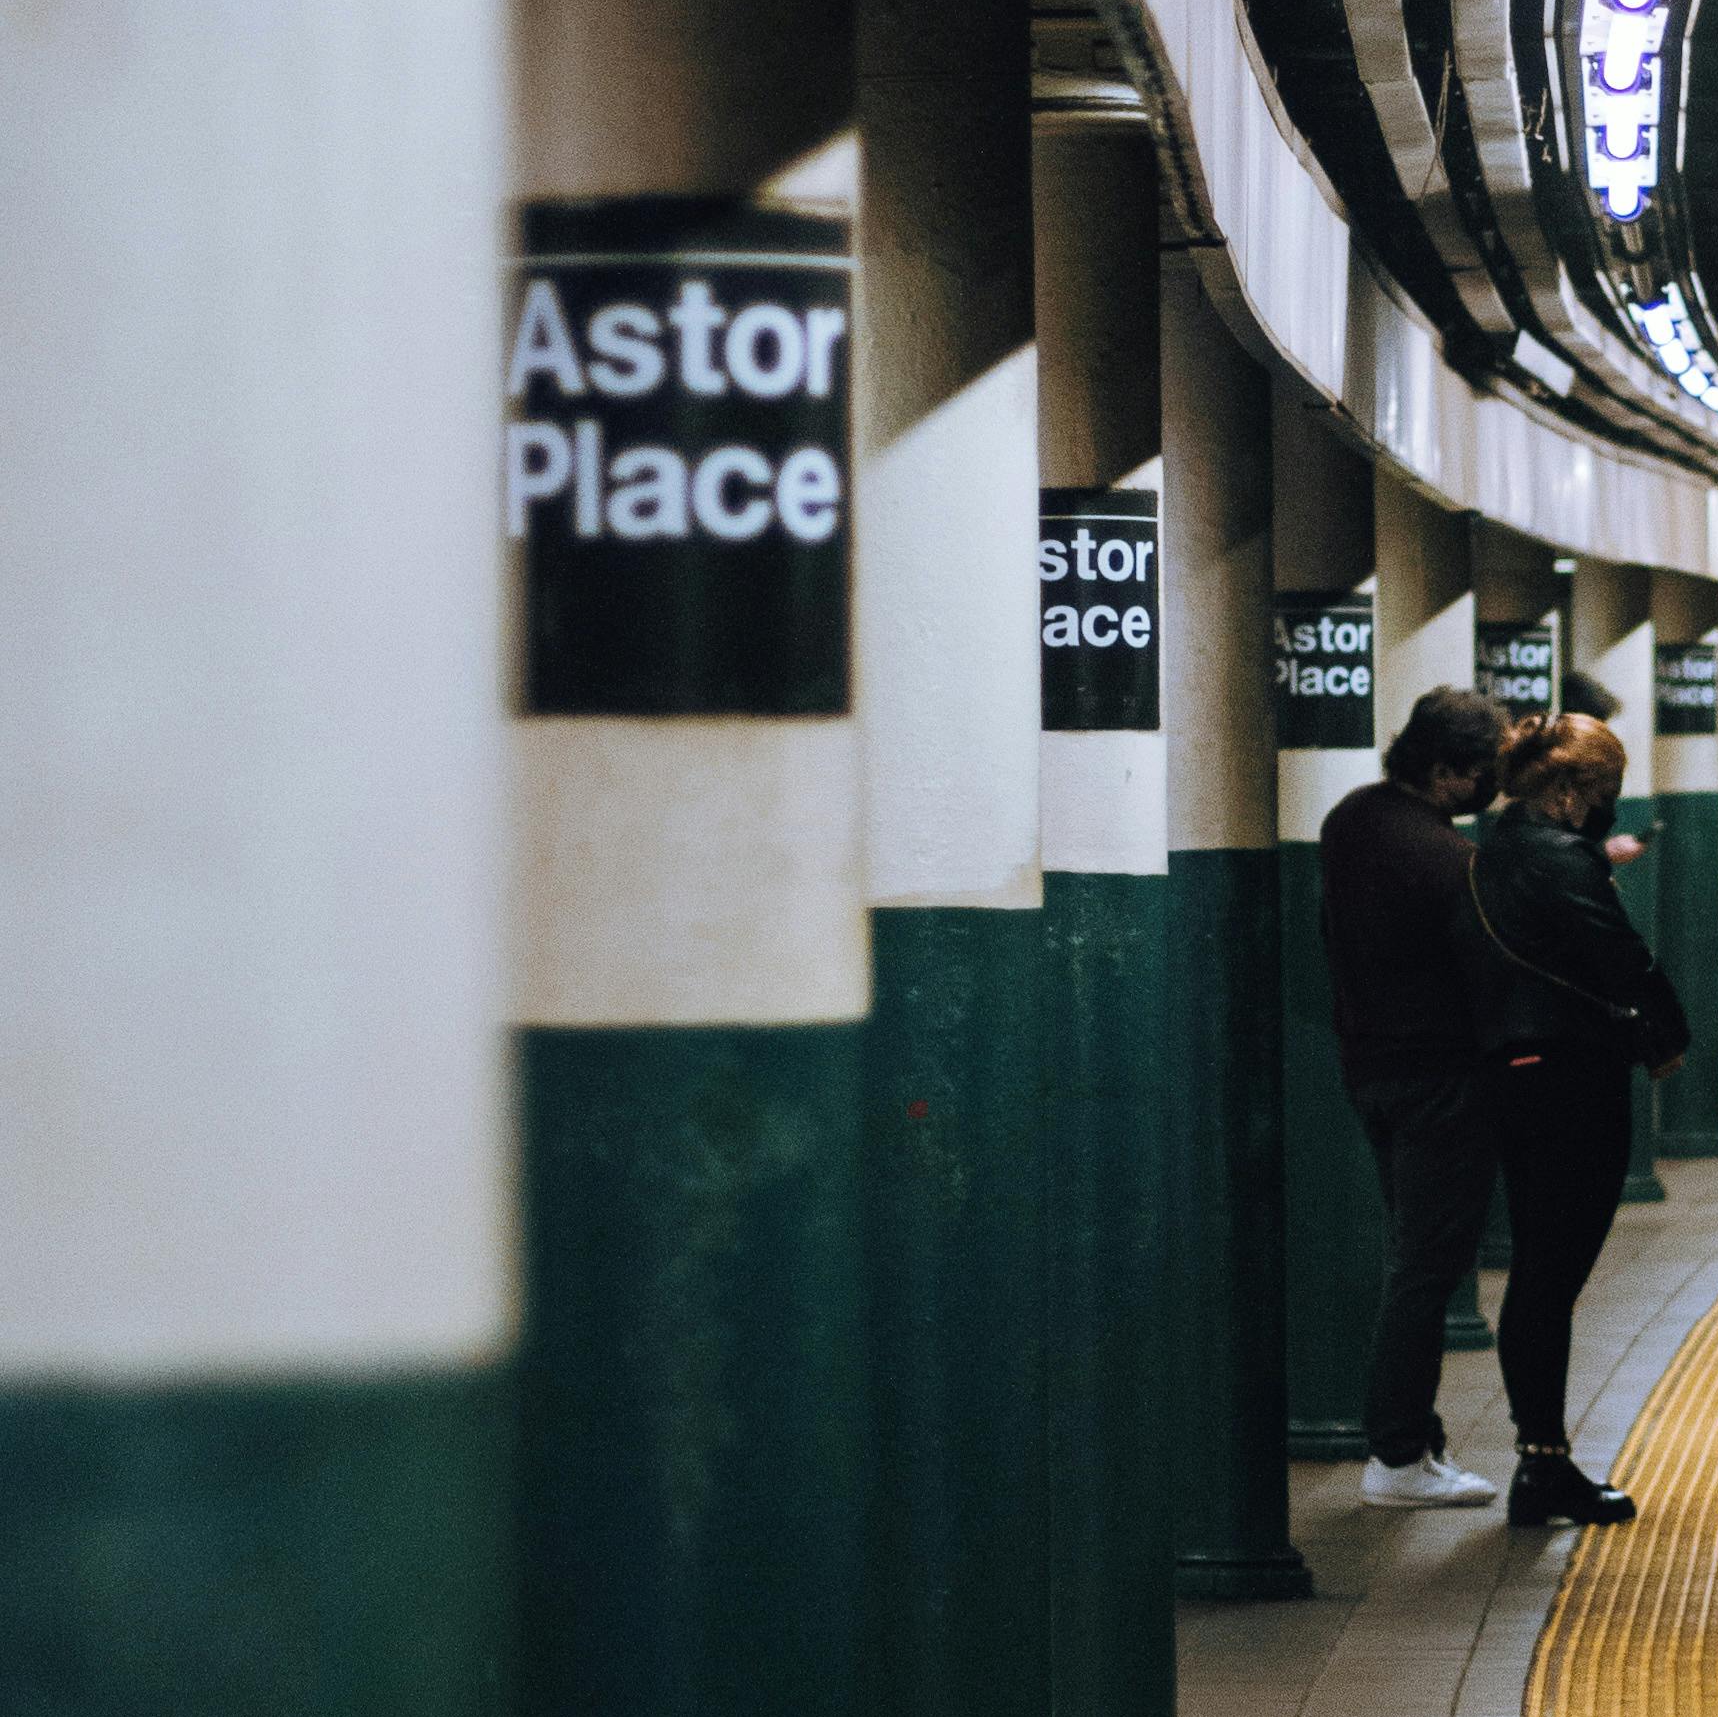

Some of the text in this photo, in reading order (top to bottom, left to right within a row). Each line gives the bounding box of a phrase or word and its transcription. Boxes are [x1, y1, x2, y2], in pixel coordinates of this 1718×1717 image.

[508, 279, 845, 398] Astor
[506, 419, 841, 544] Place
[1040, 528, 1153, 582] stor
[1042, 604, 1151, 649] ace
